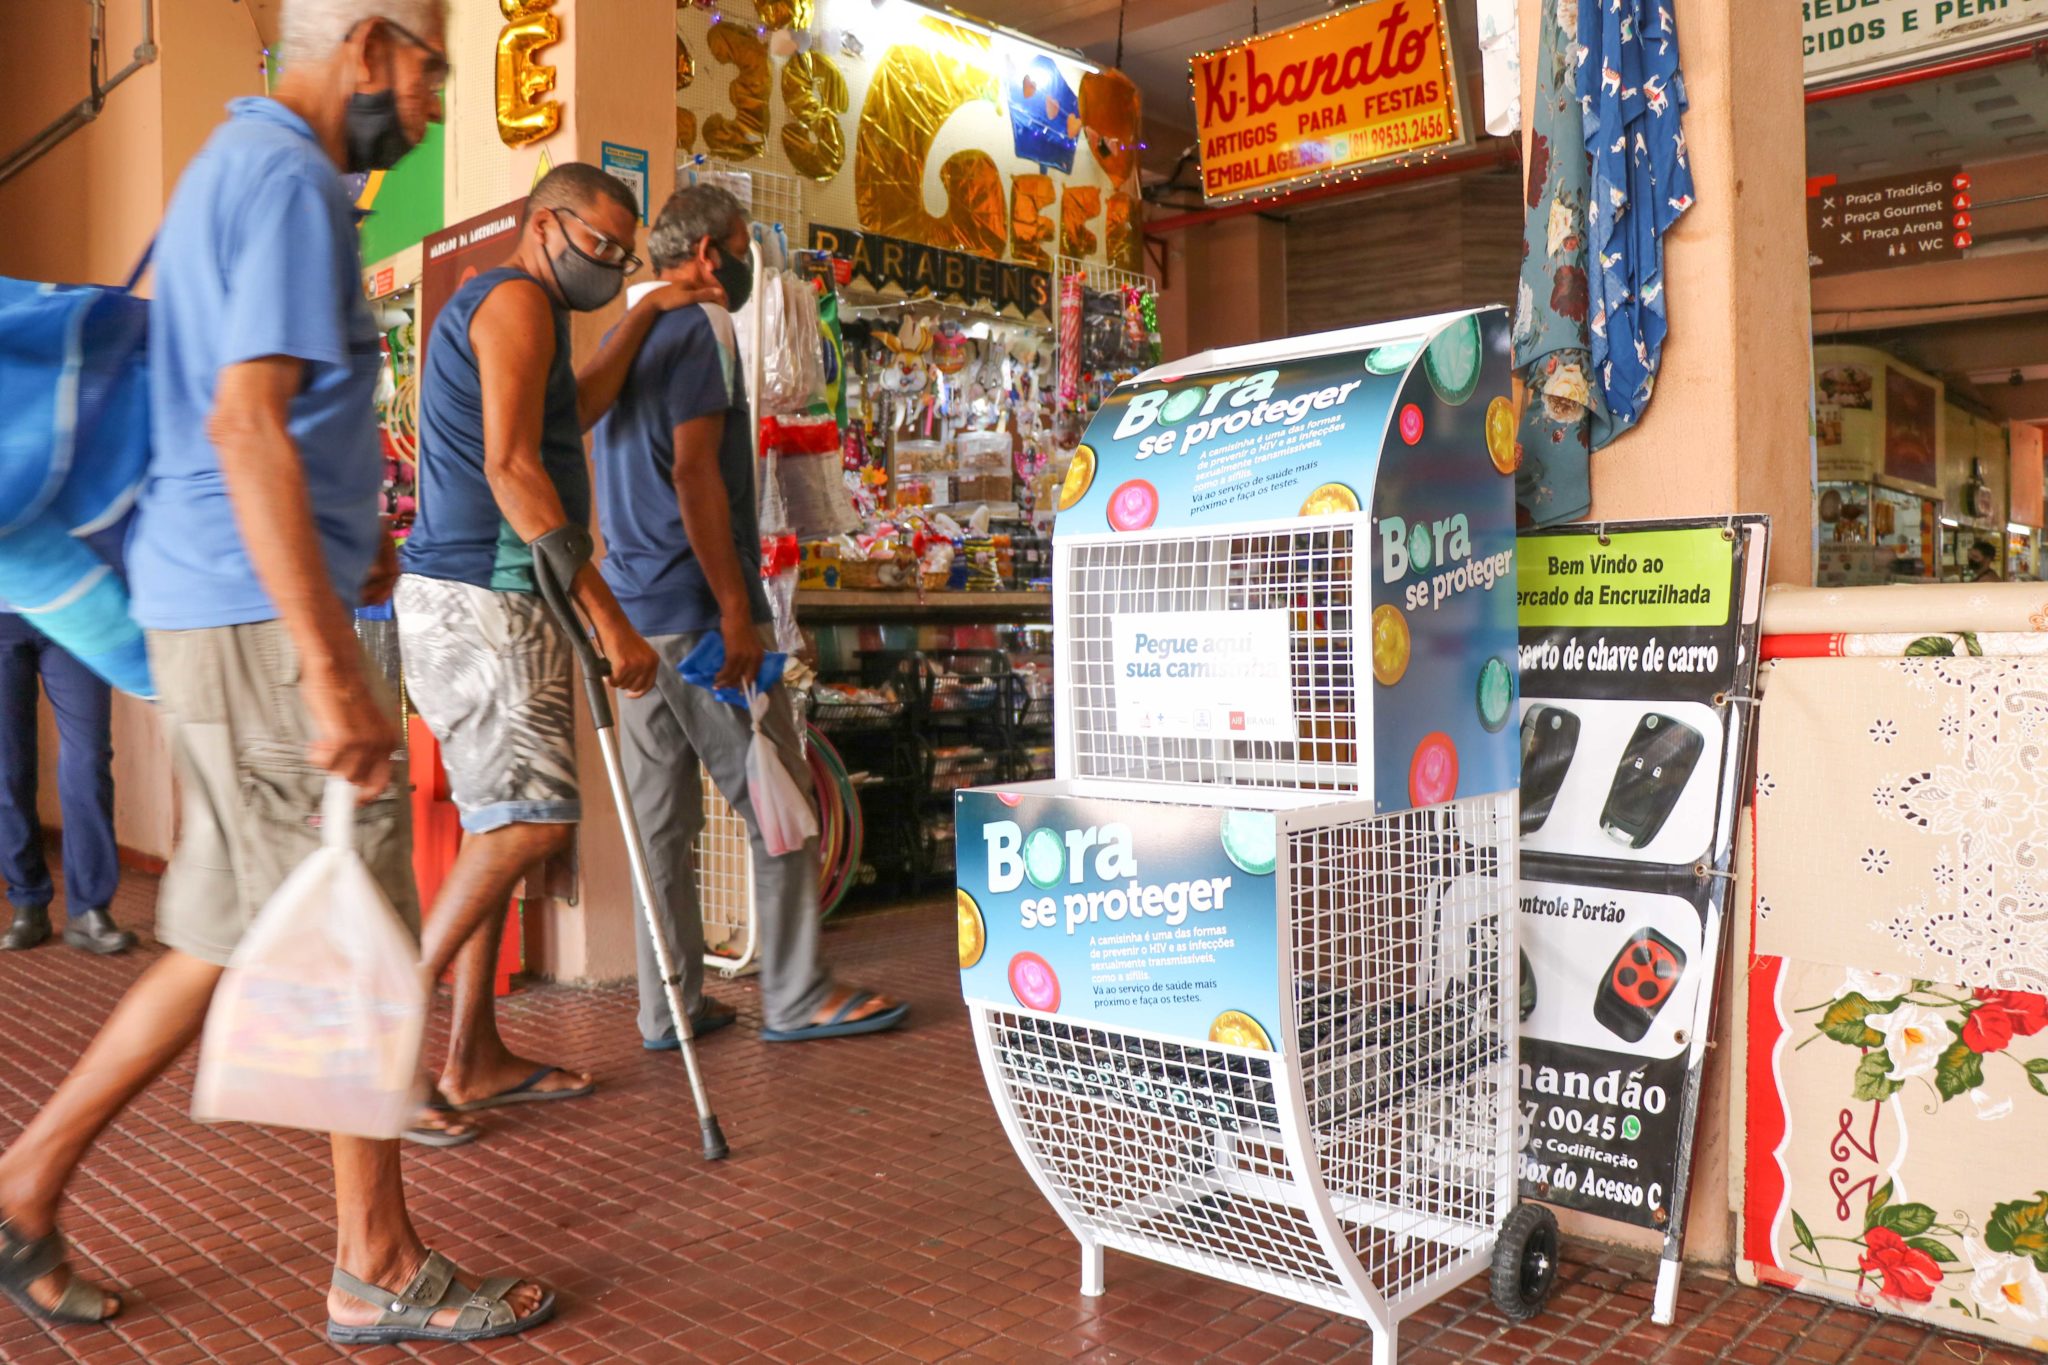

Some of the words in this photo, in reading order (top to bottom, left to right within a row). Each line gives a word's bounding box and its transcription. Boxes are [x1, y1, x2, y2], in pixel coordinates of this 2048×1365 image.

[1902, 9, 1919, 33] E
[1206, 122, 1278, 160] ARTIGOS
[1298, 104, 1347, 135] PARA
[1364, 80, 1439, 118] FESTAS
[1370, 117, 1444, 153] 99533.2456
[1846, 189, 1882, 206] Praça
[1885, 181, 1943, 201] Tradição
[1844, 208, 1880, 225] Praça
[1883, 200, 1943, 219] Gourmet
[1863, 224, 1900, 241] Praça
[1903, 219, 1943, 235] Arena
[1919, 238, 1944, 252] WC
[1112, 370, 1279, 442] Bora
[1135, 434, 1174, 461] se
[1180, 377, 1363, 457] proteger
[1208, 437, 1255, 457] camisinha
[1265, 429, 1286, 441] uma
[1288, 424, 1305, 435] das
[1307, 414, 1342, 429] formas
[1209, 448, 1248, 469] prevenir
[1258, 440, 1278, 453] HIV
[1286, 436, 1297, 445] as
[1204, 491, 1216, 500] ao
[1217, 480, 1250, 497] serviço
[1252, 475, 1264, 485] de
[1265, 467, 1293, 482] saúde
[1295, 460, 1318, 473] mais
[1190, 498, 1228, 516] próximo
[1236, 488, 1256, 505] faça
[1257, 486, 1268, 495] os
[1379, 513, 1471, 584] Bora
[1405, 578, 1427, 612] se
[1432, 548, 1513, 611] proteger
[1548, 556, 1584, 576] Bem
[1589, 554, 1637, 574] Vindo
[1643, 557, 1664, 573] ao
[1574, 586, 1594, 606] da
[1599, 584, 1711, 605] Encruzilhada
[1134, 632, 1198, 659] Pegue
[1202, 632, 1253, 658] aqui
[1563, 637, 1584, 671] de
[1587, 637, 1639, 672] chave
[1642, 637, 1664, 672] de
[1667, 646, 1718, 673] carro
[1125, 661, 1162, 679] sua
[983, 820, 1137, 894] Bora
[1020, 896, 1056, 929] se
[1064, 876, 1231, 935] proteger
[1572, 897, 1625, 923] Portão
[1090, 949, 1101, 958] de
[1102, 945, 1139, 959] prevenir
[1149, 943, 1168, 954] HIV
[1177, 943, 1187, 952] as
[1189, 938, 1235, 951] infecções
[1098, 931, 1143, 945] camisinha
[1152, 932, 1173, 941] uma
[1175, 928, 1191, 938] das
[1193, 925, 1227, 937] formas
[1094, 995, 1130, 1009] próximo
[1139, 995, 1158, 1008] faça
[1160, 996, 1171, 1004] os
[1173, 993, 1202, 1003] testes.
[1118, 984, 1150, 997] serviço
[1152, 982, 1163, 991] de
[1165, 979, 1193, 990] saúde
[1195, 979, 1217, 989] mais
[1532, 1138, 1543, 1149] e
[1546, 1138, 1639, 1170] Codificação
[1553, 1162, 1577, 1192] do
[1580, 1166, 1644, 1206] Acesso
[1648, 1183, 1662, 1210] C
